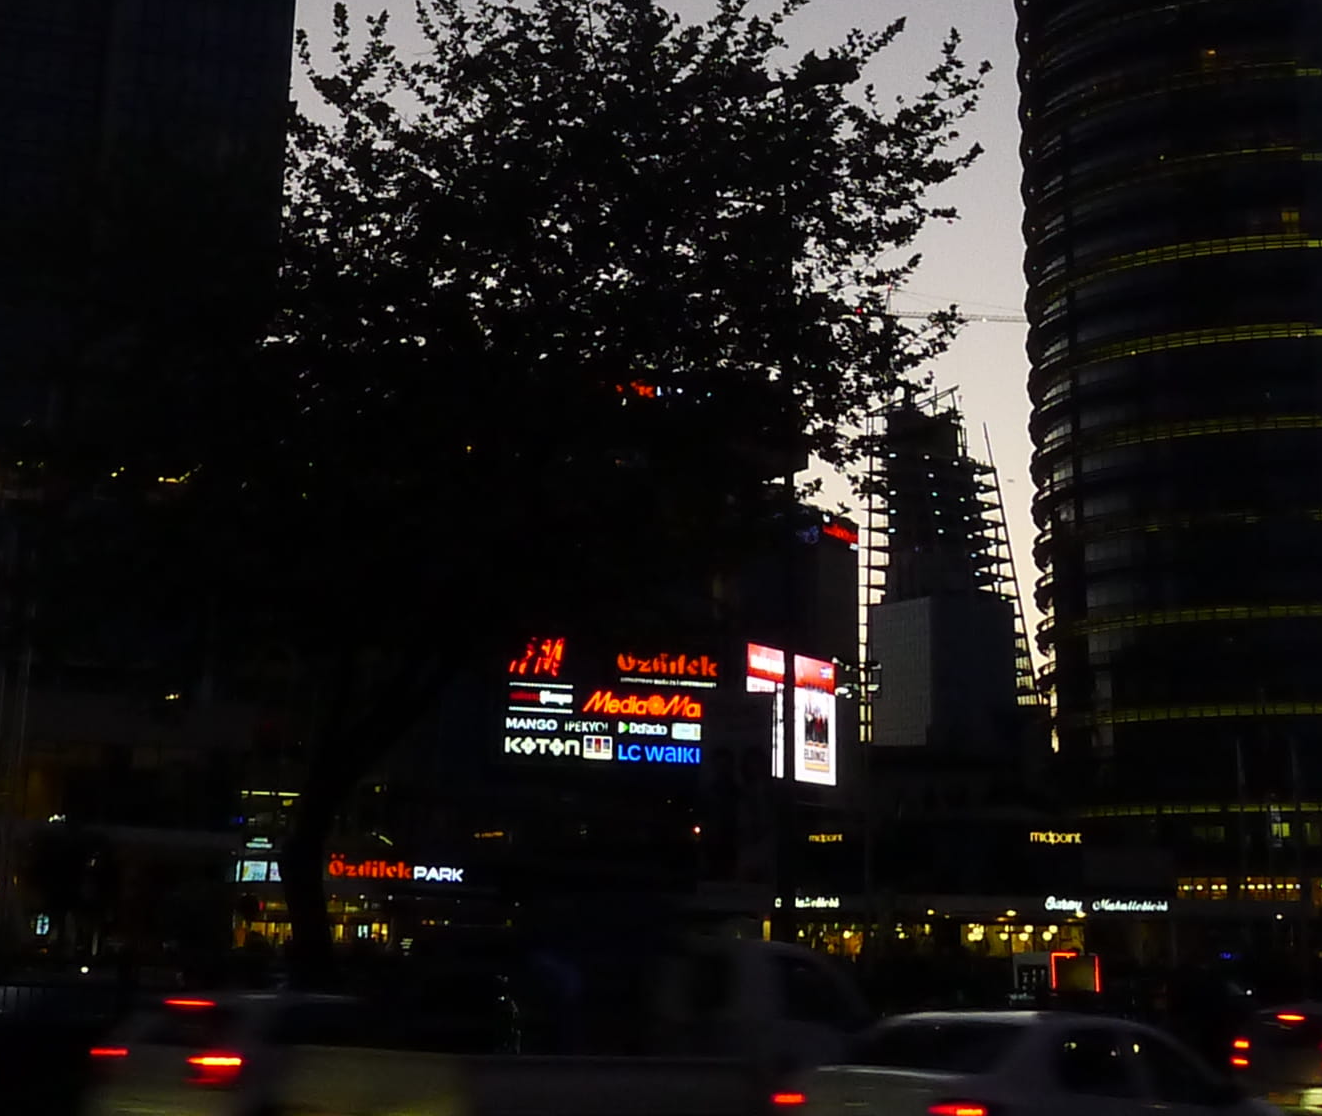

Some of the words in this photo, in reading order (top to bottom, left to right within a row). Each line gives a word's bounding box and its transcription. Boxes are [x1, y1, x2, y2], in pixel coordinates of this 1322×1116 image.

[505, 716, 559, 732] MANGO
[617, 743, 641, 762] LC
[1029, 830, 1082, 846] midpoint
